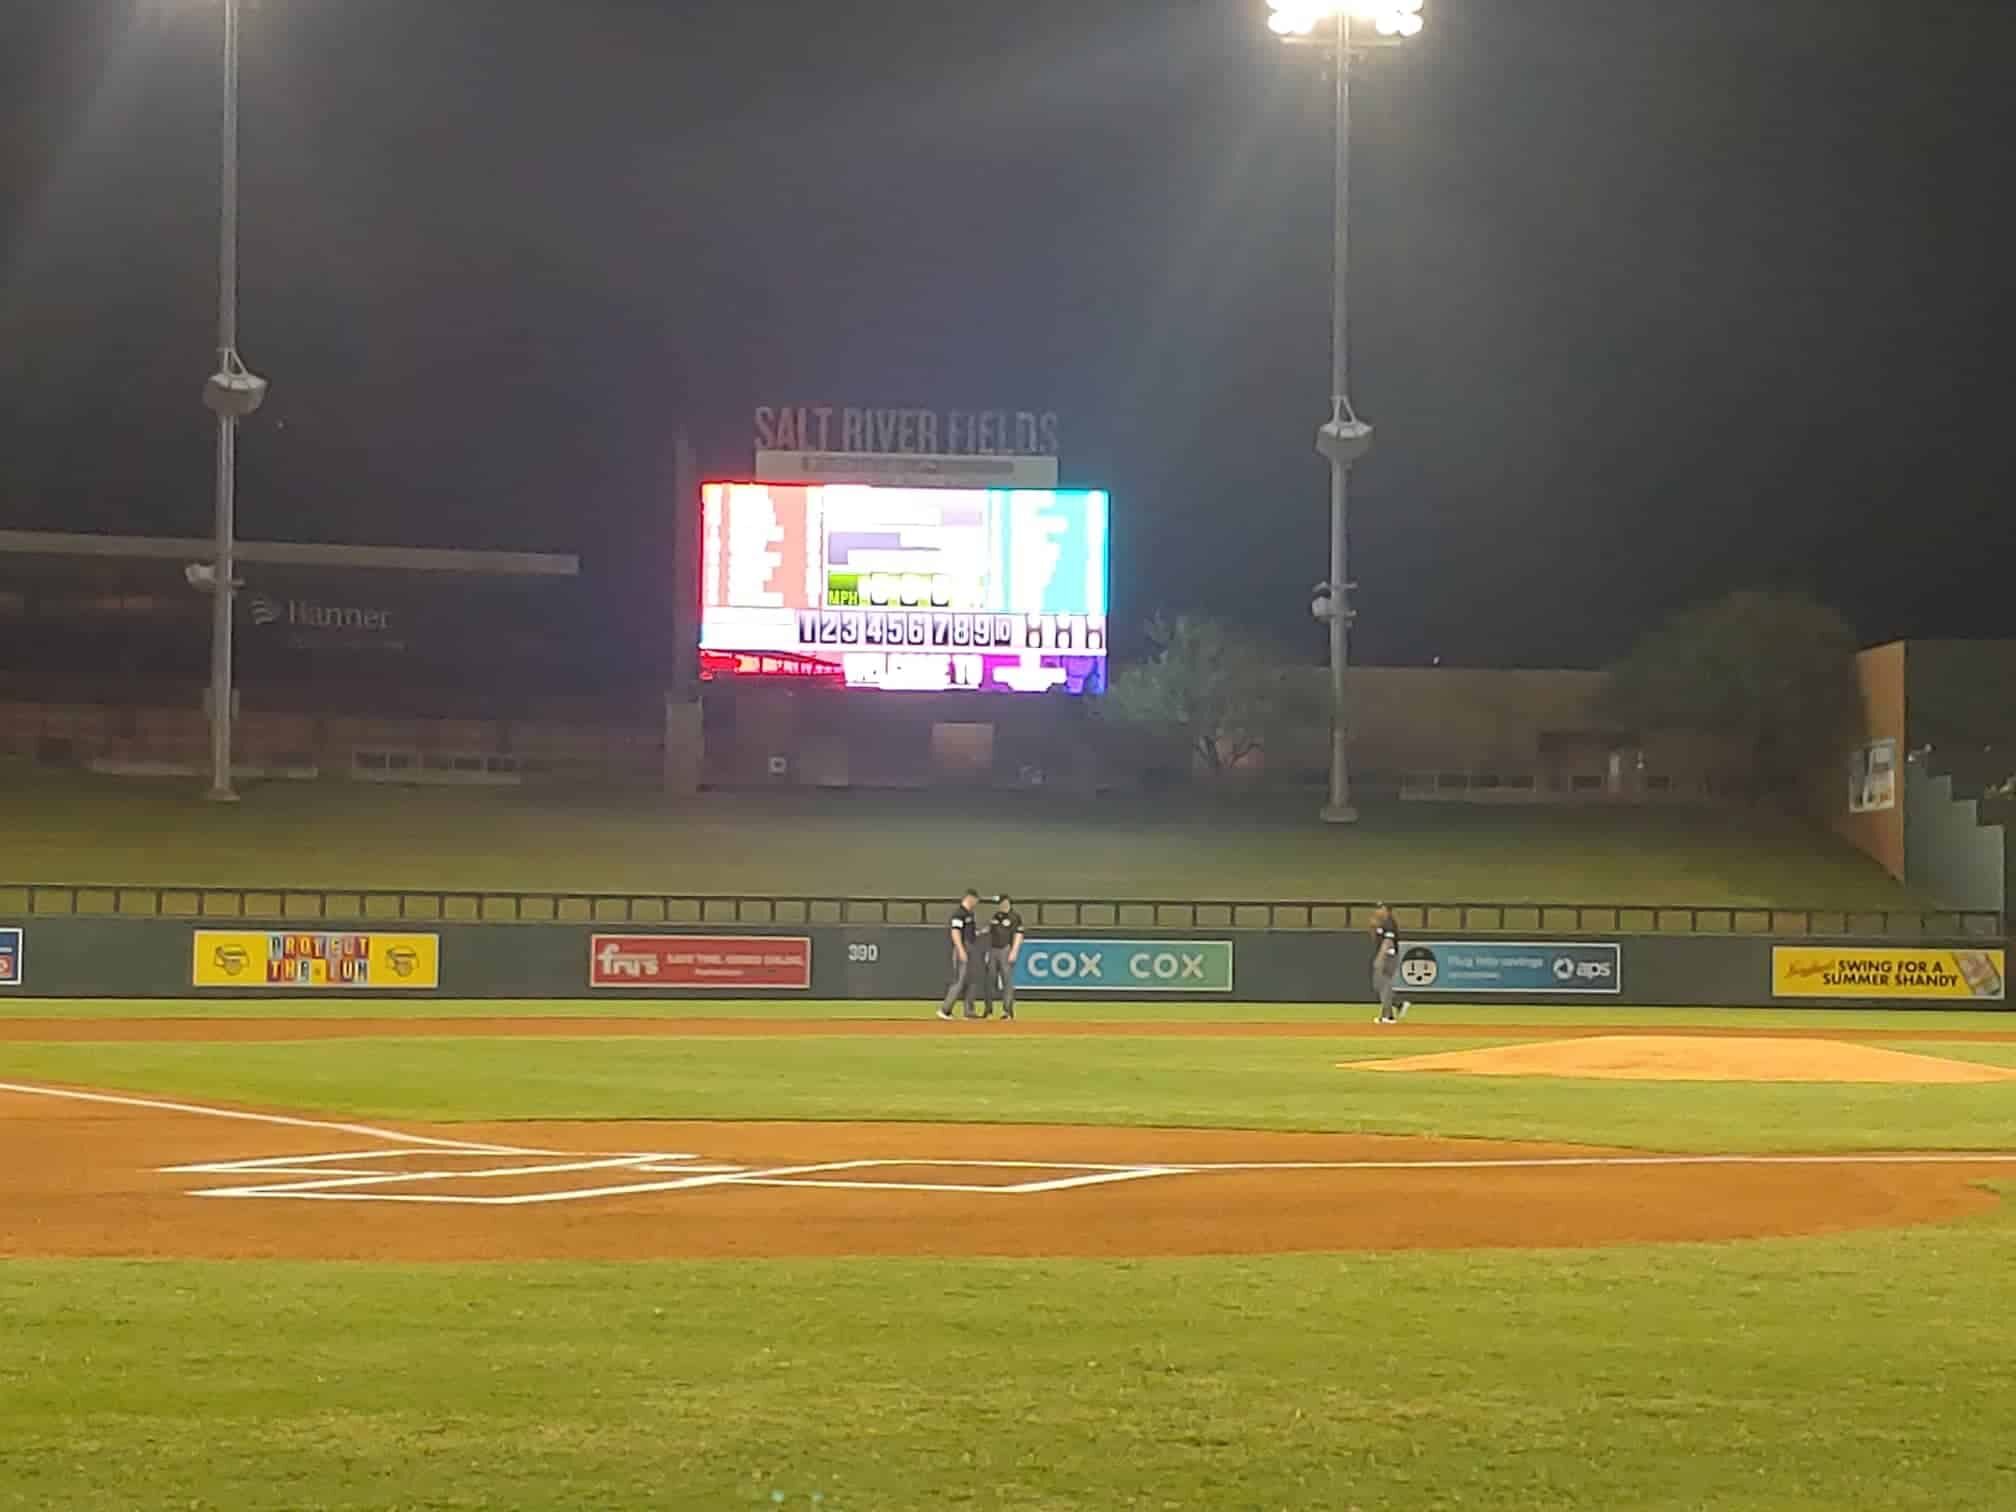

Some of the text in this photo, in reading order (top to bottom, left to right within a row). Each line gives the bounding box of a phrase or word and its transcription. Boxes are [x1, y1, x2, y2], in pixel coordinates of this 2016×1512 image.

[754, 406, 1060, 454] SALT RIVER FIELDS
[820, 614, 839, 643] 2
[840, 614, 857, 643] 3
[866, 614, 883, 643] 4
[886, 614, 903, 644] 5
[907, 614, 924, 644] 6
[932, 615, 949, 645] 7
[953, 615, 970, 645] 8
[974, 615, 990, 645] 9
[1027, 951, 1204, 979] COX COX
[1837, 959, 1892, 974] SWING
[1897, 960, 1927, 974] FOR
[1931, 960, 1944, 974] A
[1823, 973, 1959, 988] SUMMER SHANDY
